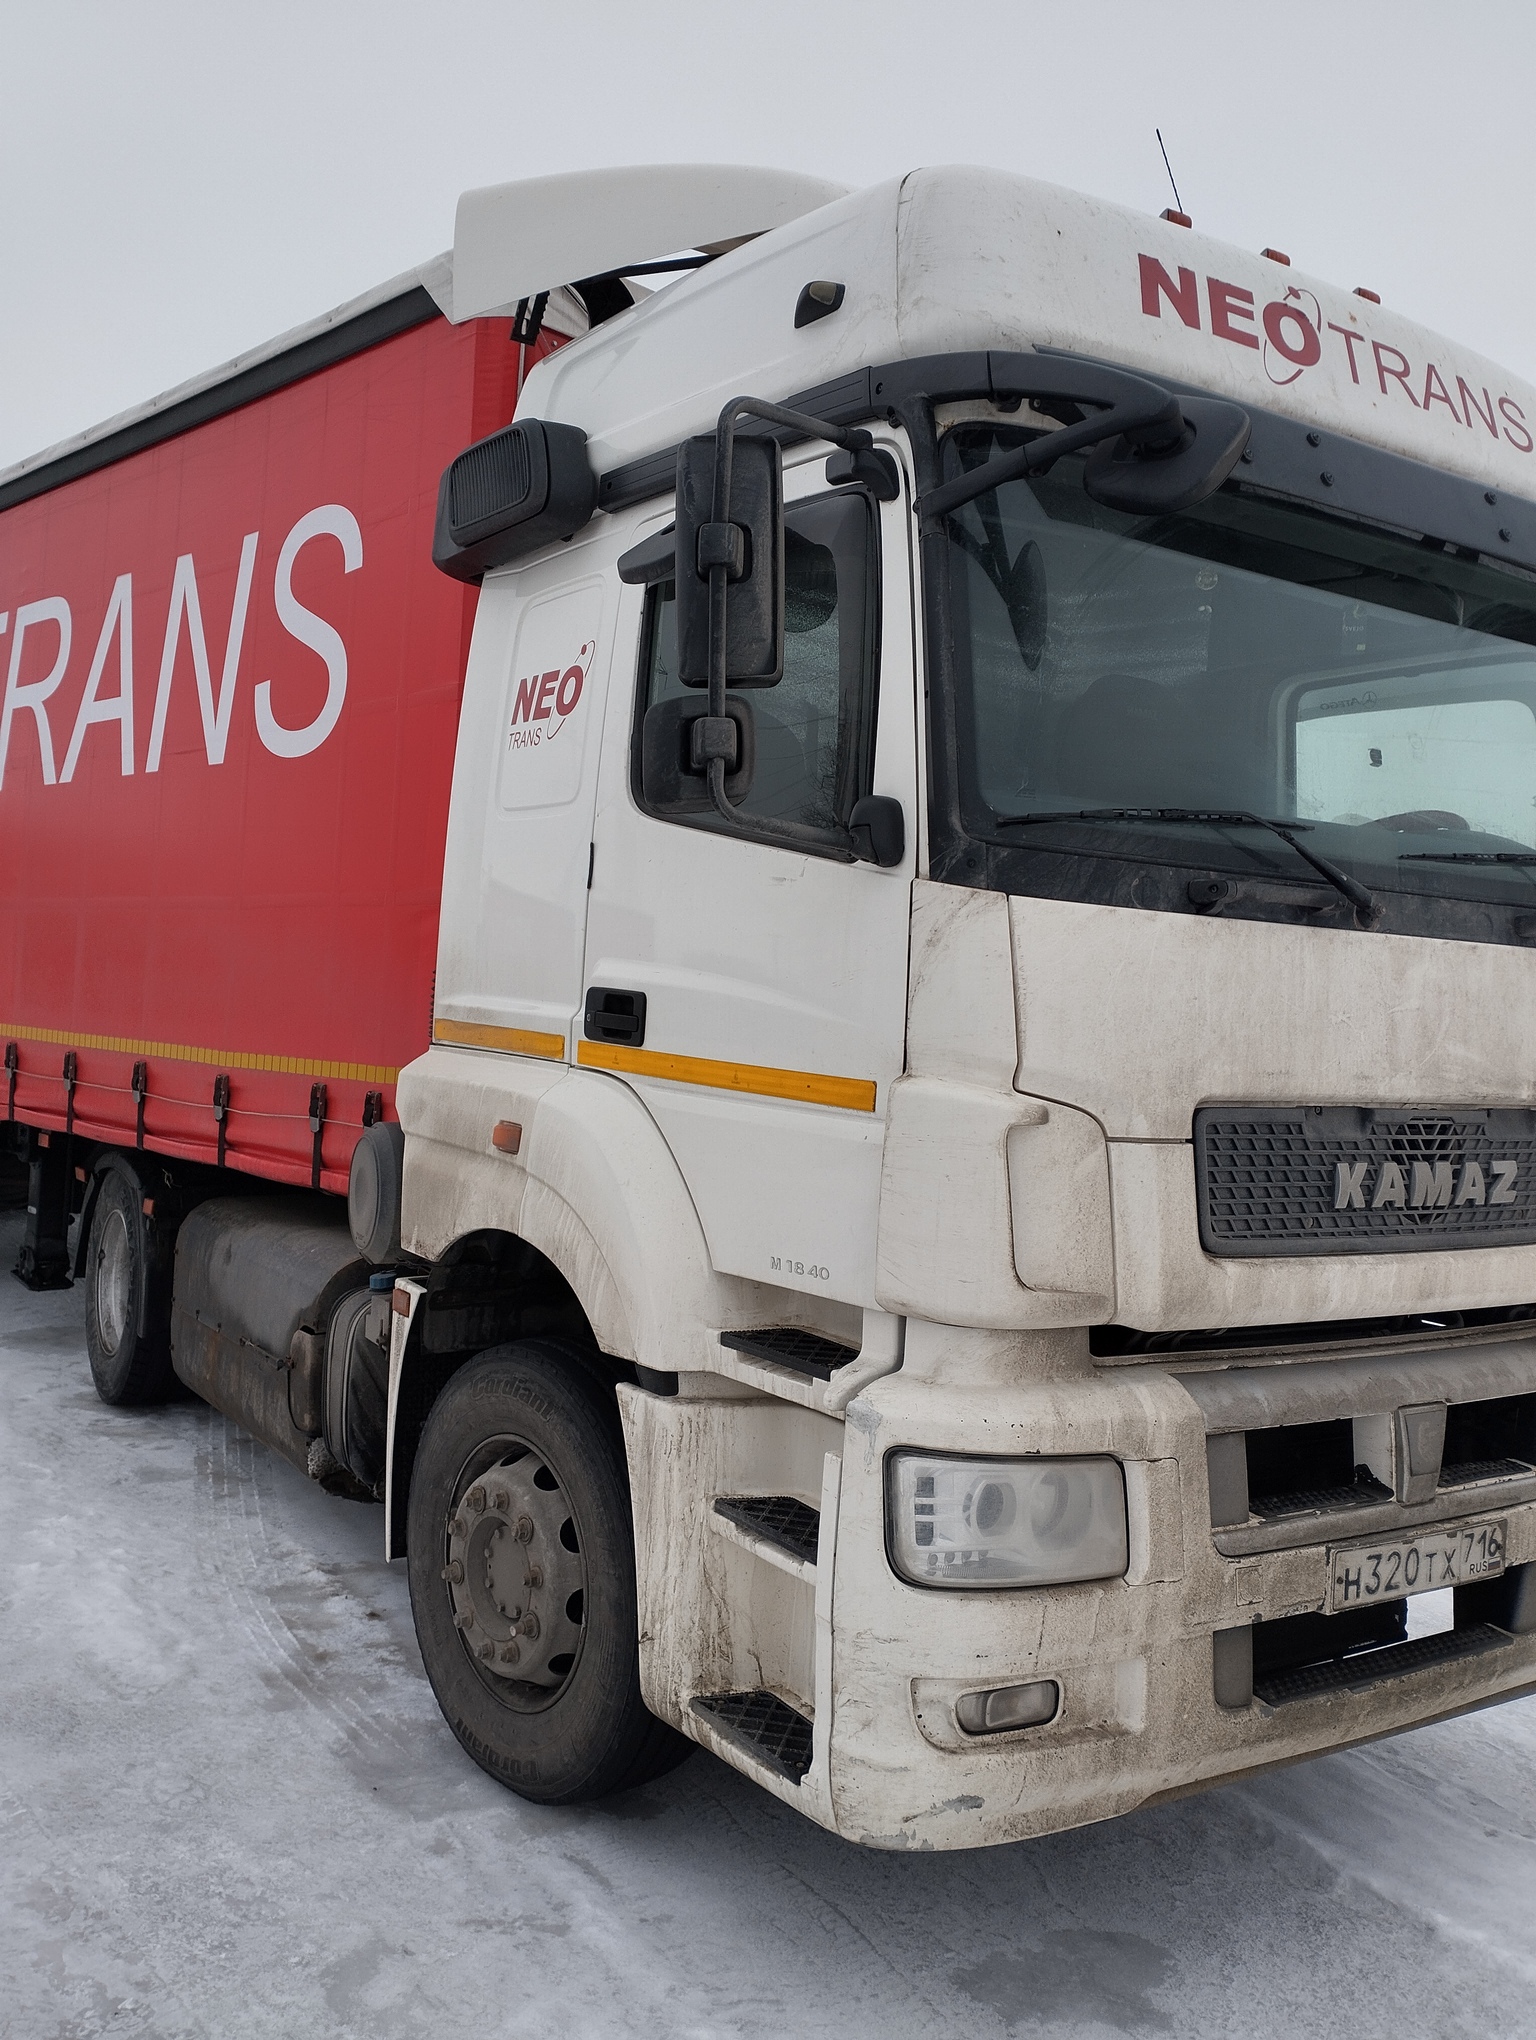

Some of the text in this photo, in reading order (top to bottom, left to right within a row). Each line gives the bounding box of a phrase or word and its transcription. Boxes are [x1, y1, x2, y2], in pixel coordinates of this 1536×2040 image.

[0, 503, 364, 791] RANS
[511, 665, 584, 726] NEO
[508, 727, 542, 751] TRANS
[1334, 1160, 1519, 1209] KAMAZ
[786, 1260, 830, 1280] 1840
[470, 1373, 556, 1422] Cordiant
[1464, 1527, 1499, 1563] 716
[1469, 1560, 1488, 1575] RUS
